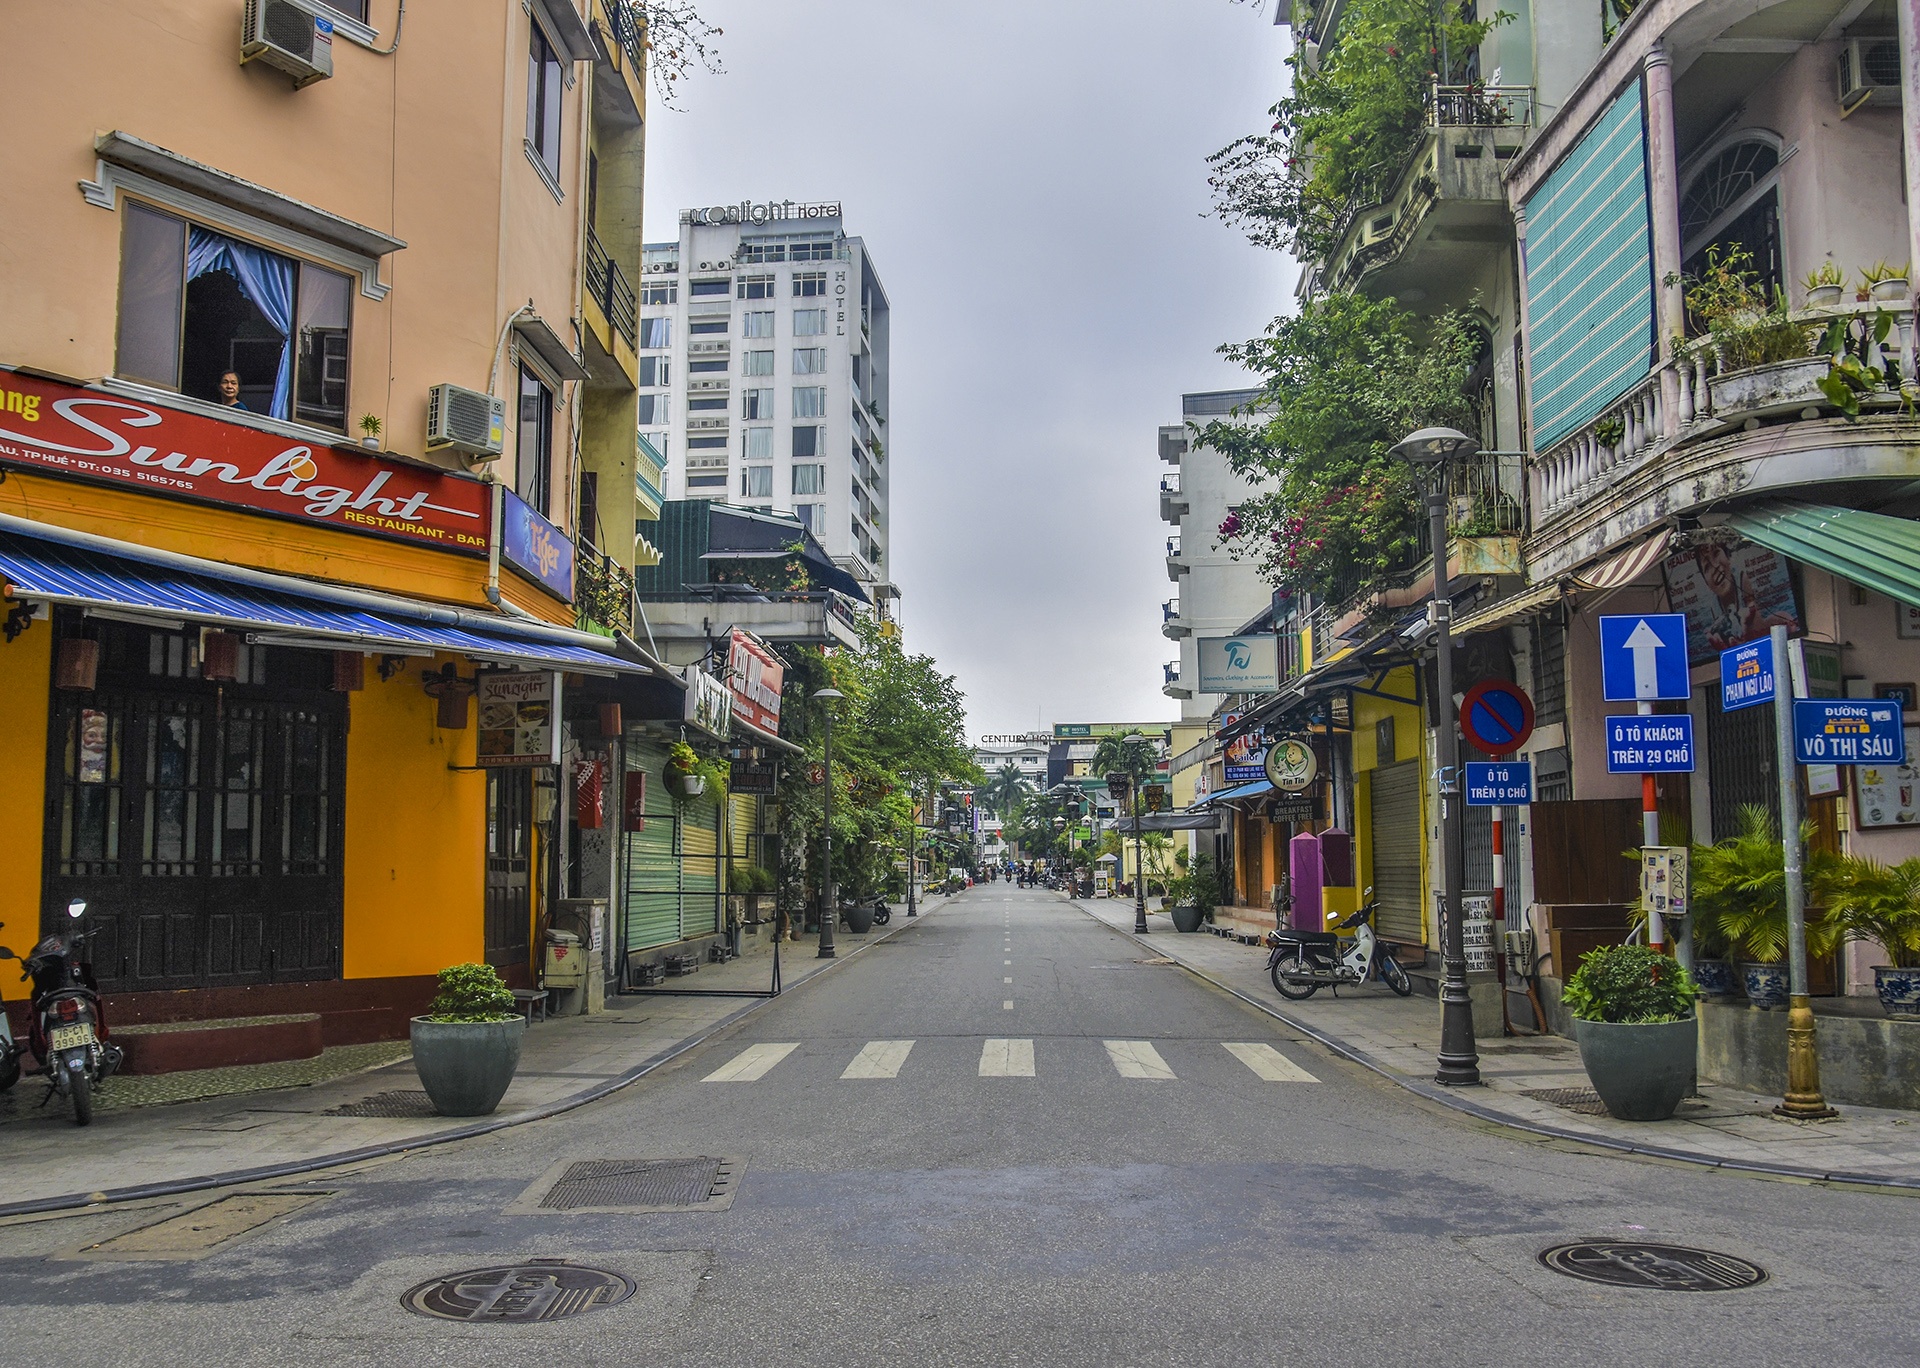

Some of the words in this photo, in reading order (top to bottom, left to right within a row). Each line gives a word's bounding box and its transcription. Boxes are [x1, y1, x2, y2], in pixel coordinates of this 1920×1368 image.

[835, 271, 846, 336] HOTEL
[0, 398, 480, 520] Sunlight
[136, 472, 194, 491] 5165765
[344, 510, 446, 540] RESTAURANT
[456, 534, 487, 548] BAR
[530, 522, 561, 578] Tiger
[1666, 550, 1697, 570] HEALING
[1669, 584, 1684, 598] Shop
[1736, 648, 1758, 662] ĐƯỜNG
[1725, 681, 1745, 703] PHẠM
[1759, 671, 1773, 693] LÃO
[1825, 705, 1869, 717] ĐƯỜNG
[981, 734, 1029, 743] CENTURY
[1615, 725, 1623, 742] Ô
[1626, 725, 1641, 742] TÔ
[1644, 725, 1683, 741] KHÁCH
[1613, 748, 1644, 764] TRÊN
[1647, 750, 1662, 764] 29
[1664, 743, 1689, 763] CHỖ
[1804, 734, 1825, 756] VÕ
[1830, 738, 1858, 760] THỊ
[1861, 734, 1893, 756] SÁU
[1234, 753, 1258, 762] Tailor
[1294, 777, 1305, 785] Tin
[1487, 769, 1494, 782] Ô
[1497, 769, 1509, 782] TÔ
[1470, 785, 1496, 798] TRÊN
[1498, 788, 1504, 798] 9
[1507, 782, 1527, 798] CHỖ
[1273, 814, 1296, 823] COFFEE
[1297, 812, 1314, 821] FREE
[1274, 805, 1313, 816] BREAKFAST
[57, 1025, 84, 1039] 76-C1
[55, 1034, 89, 1049] 399.96
